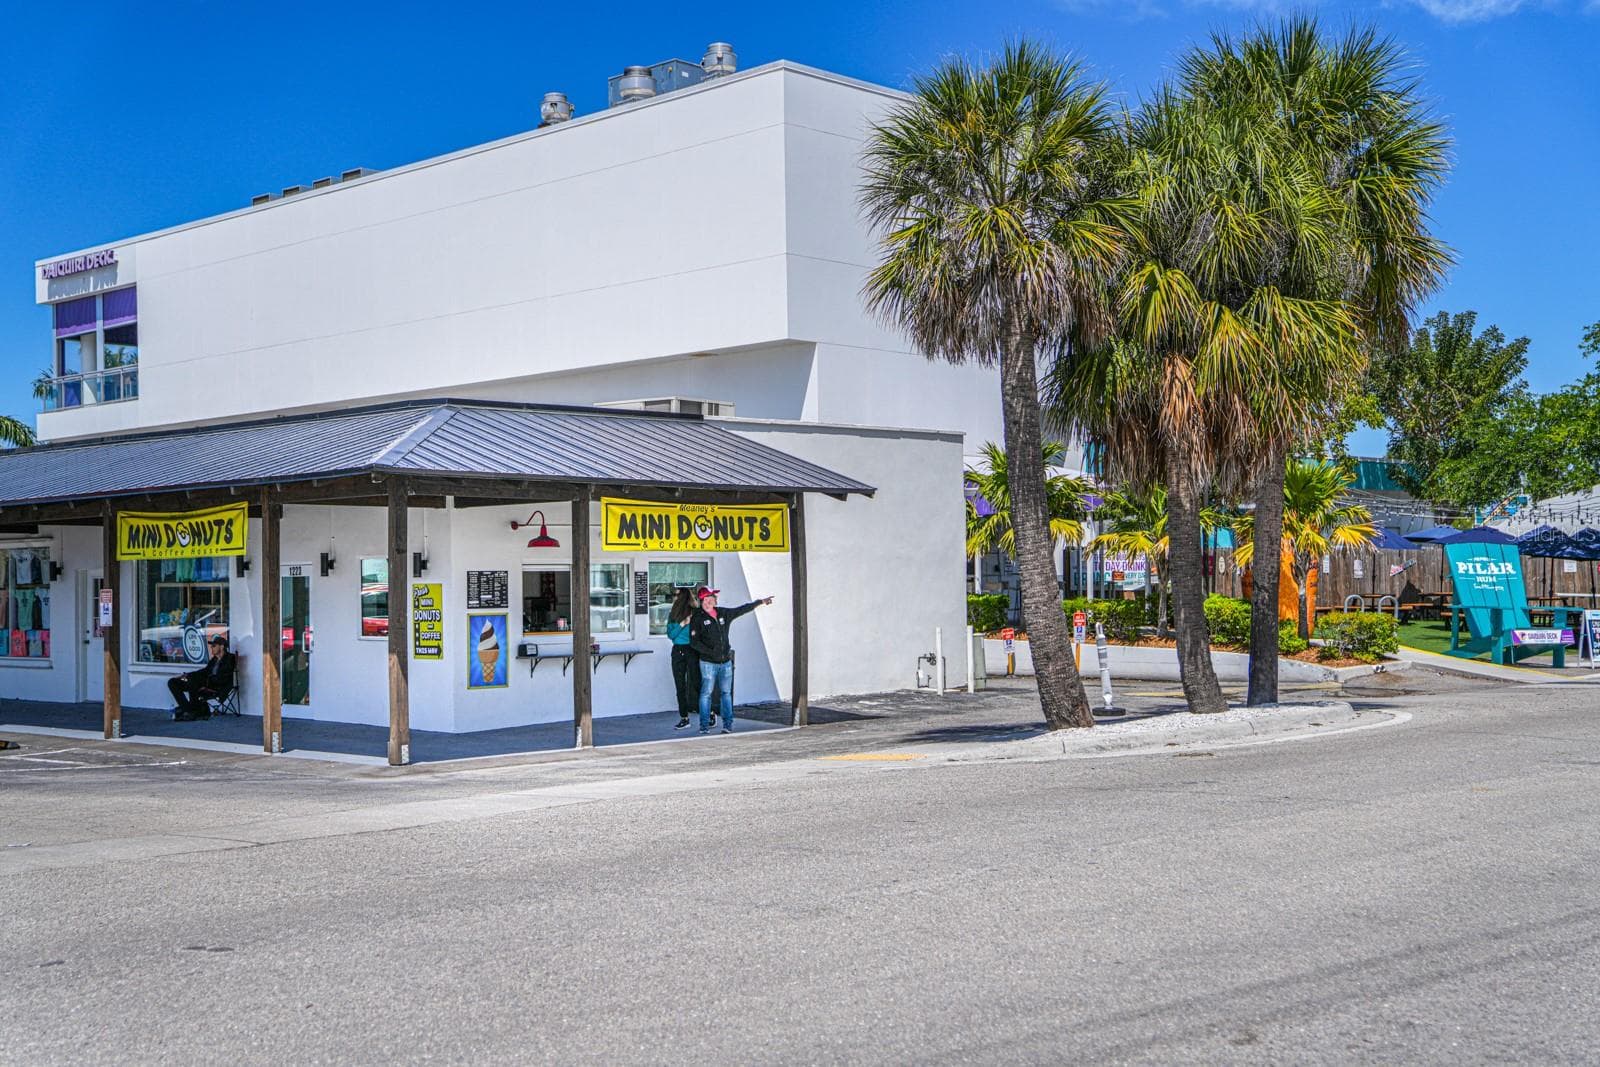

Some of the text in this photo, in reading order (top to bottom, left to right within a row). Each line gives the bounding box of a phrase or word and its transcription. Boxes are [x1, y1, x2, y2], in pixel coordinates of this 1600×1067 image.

[41, 249, 115, 279] DAIQUIRI DECK
[617, 513, 771, 541] MINI DONUTS
[127, 518, 234, 549] MINI DONUTS
[642, 541, 753, 550] & Coffee House
[153, 549, 185, 557] Coffee
[191, 548, 220, 556] House
[1105, 561, 1121, 571] DAY
[1456, 561, 1516, 575] PILAR
[414, 610, 441, 621] DONUTS
[421, 633, 441, 641] COFFEE
